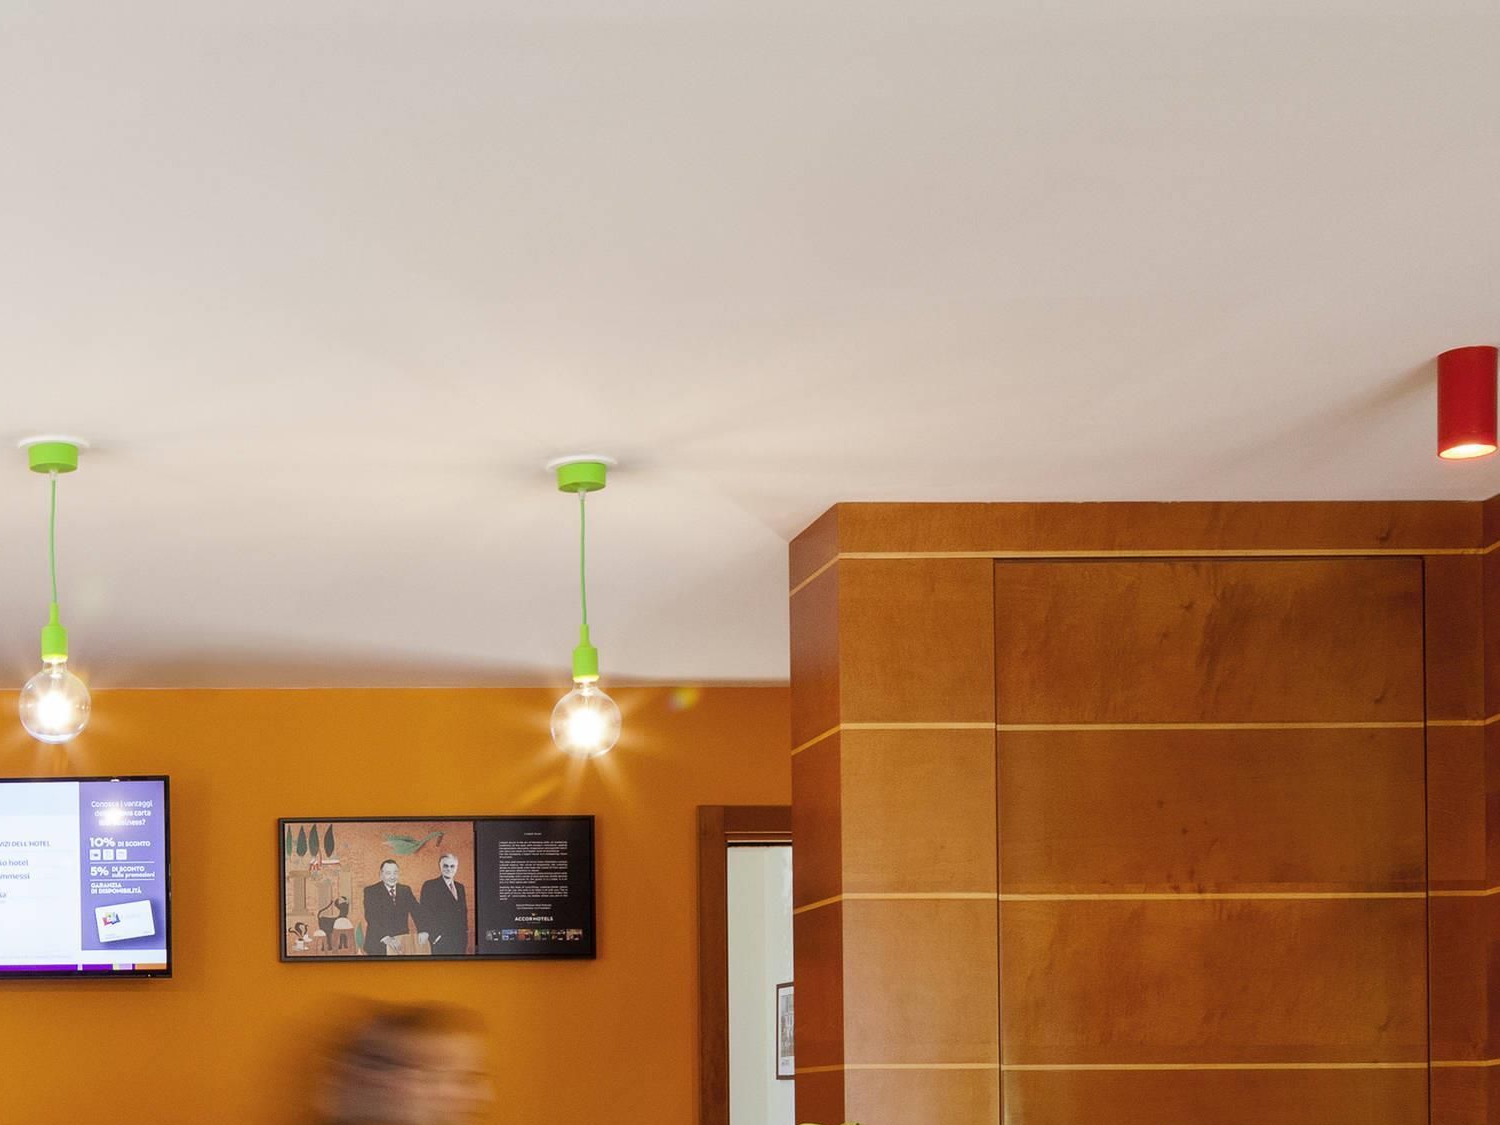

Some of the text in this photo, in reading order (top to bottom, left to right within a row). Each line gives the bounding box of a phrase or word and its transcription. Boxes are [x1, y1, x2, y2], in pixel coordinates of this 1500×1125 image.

[124, 800, 153, 808] vantaggi
[90, 837, 116, 847] 10%
[8, 859, 29, 867] hotel
[90, 866, 109, 876] 5%
